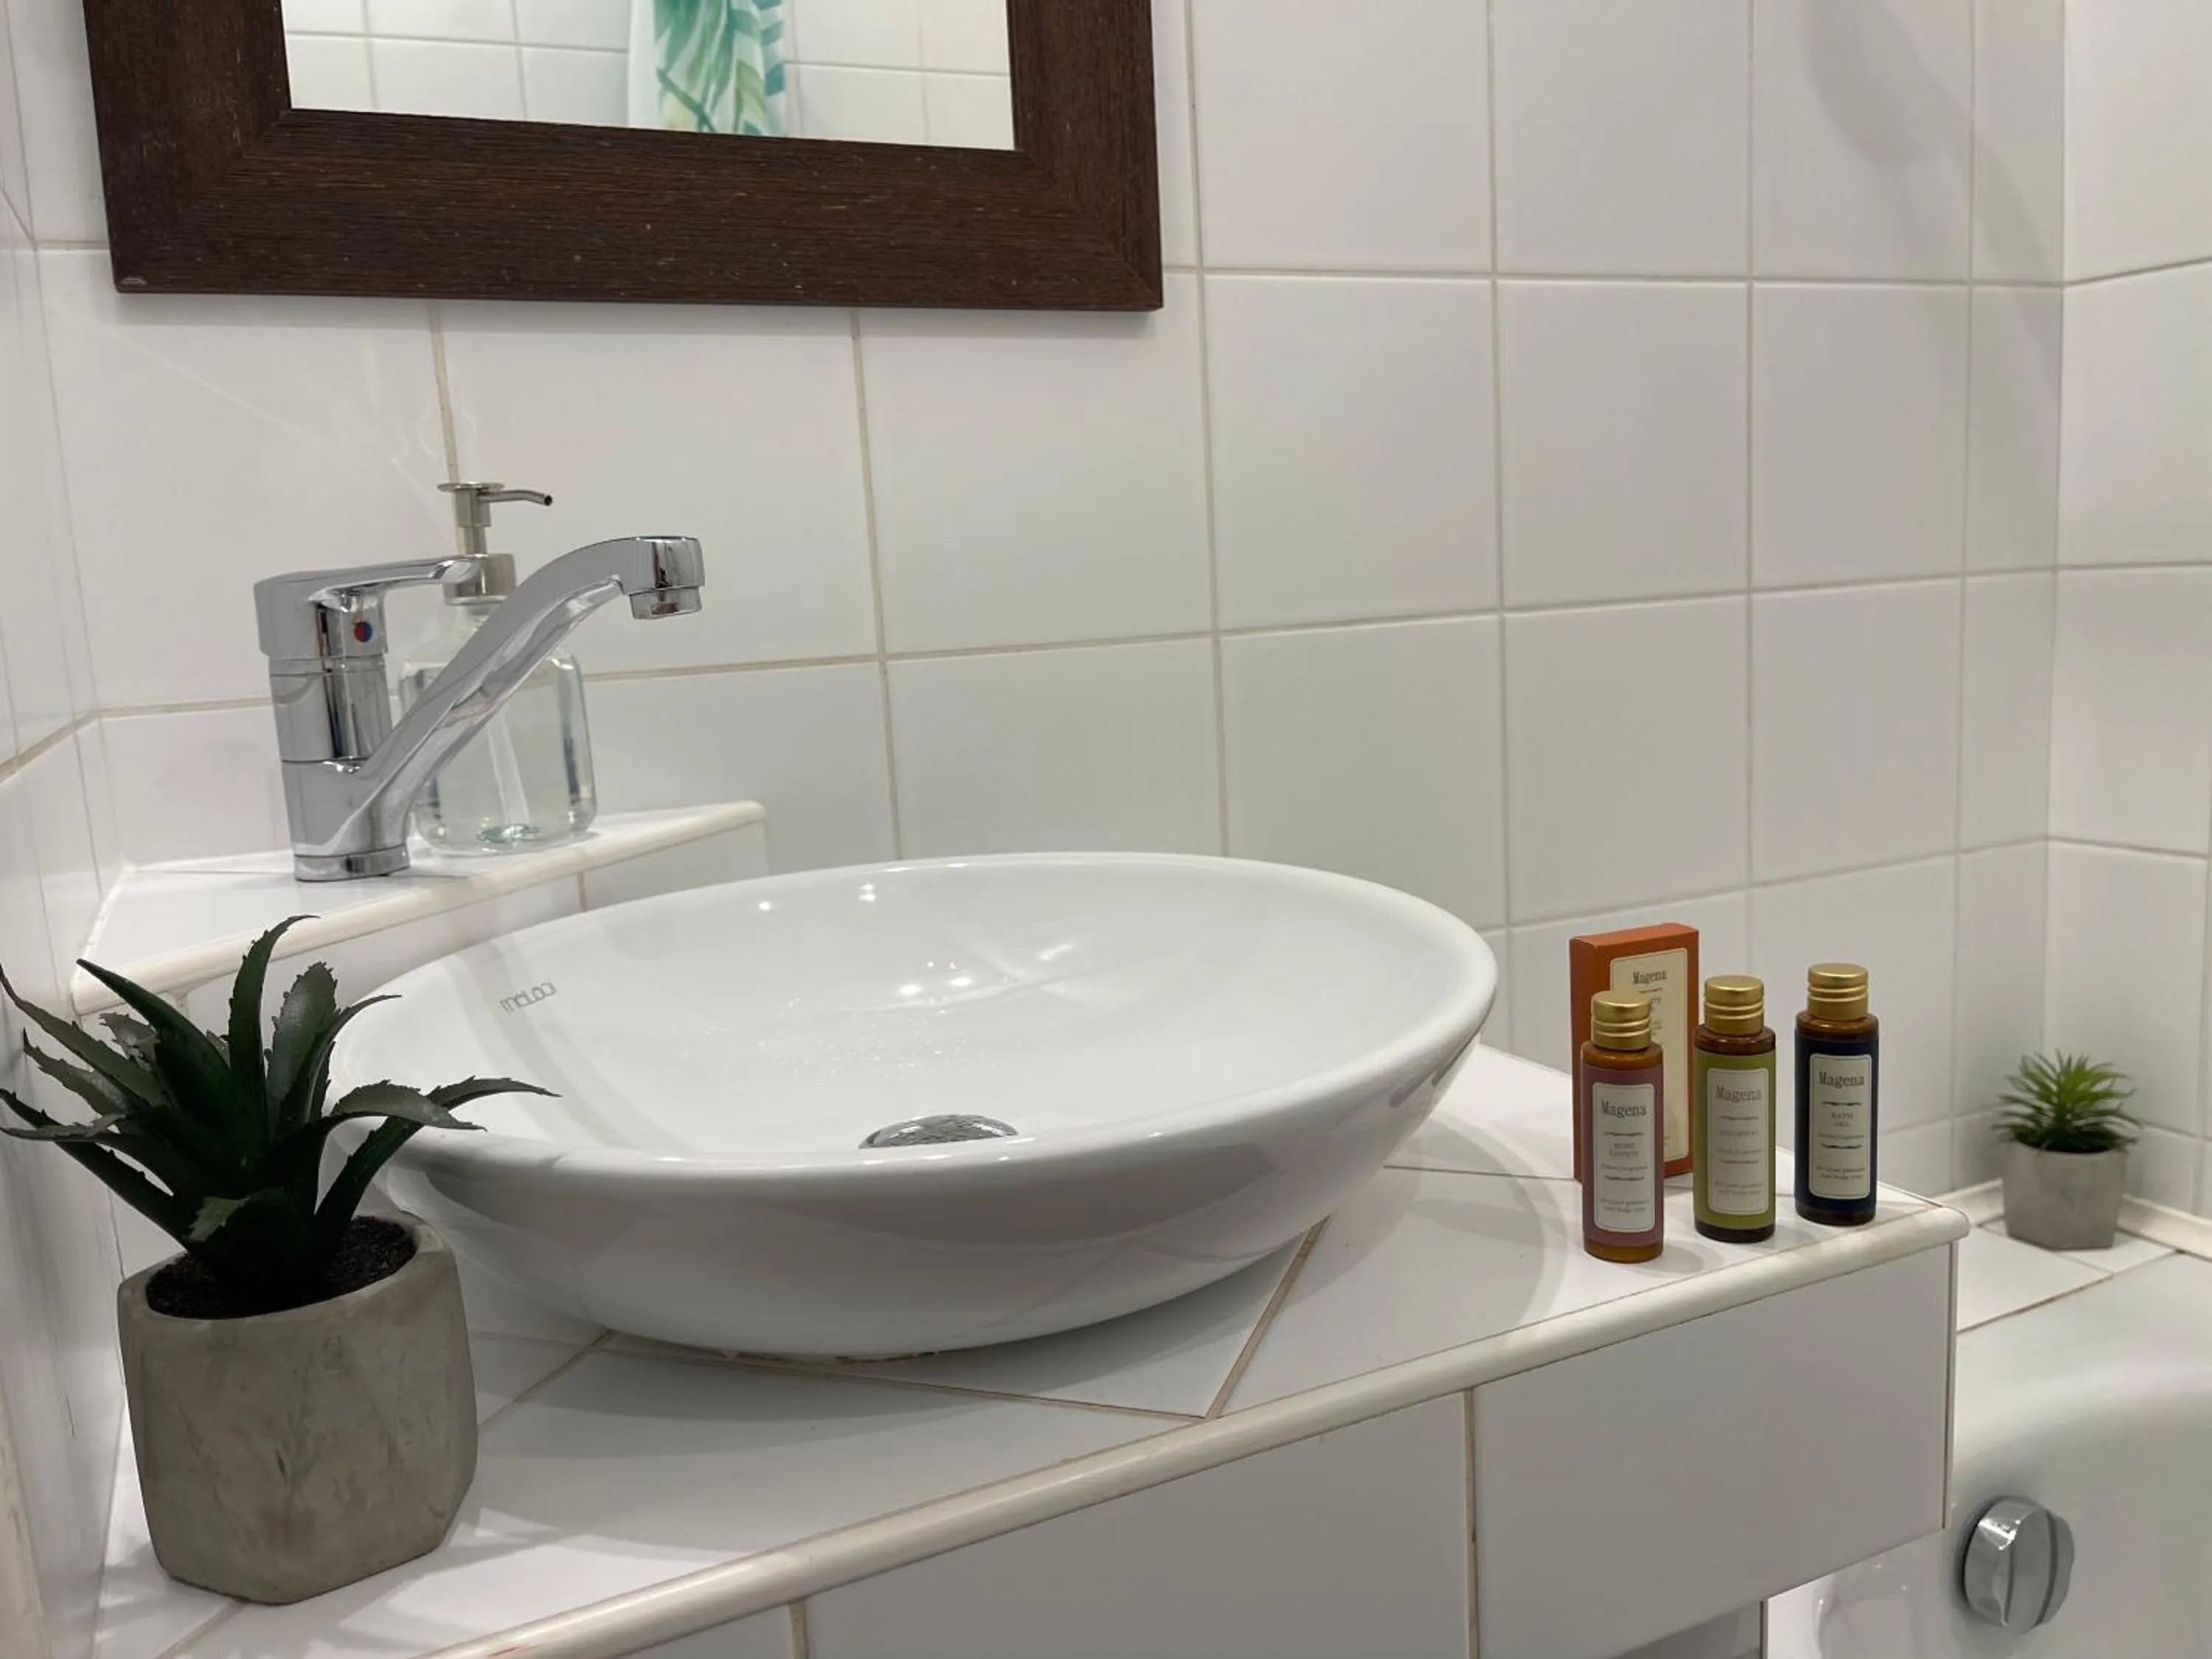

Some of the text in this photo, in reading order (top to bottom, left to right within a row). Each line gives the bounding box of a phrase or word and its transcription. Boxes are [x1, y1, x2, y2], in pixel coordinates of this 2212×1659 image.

[1818, 1071, 1865, 1089] Magena
[1716, 1085, 1762, 1103] Magena
[1601, 1099, 1647, 1119] Magena
